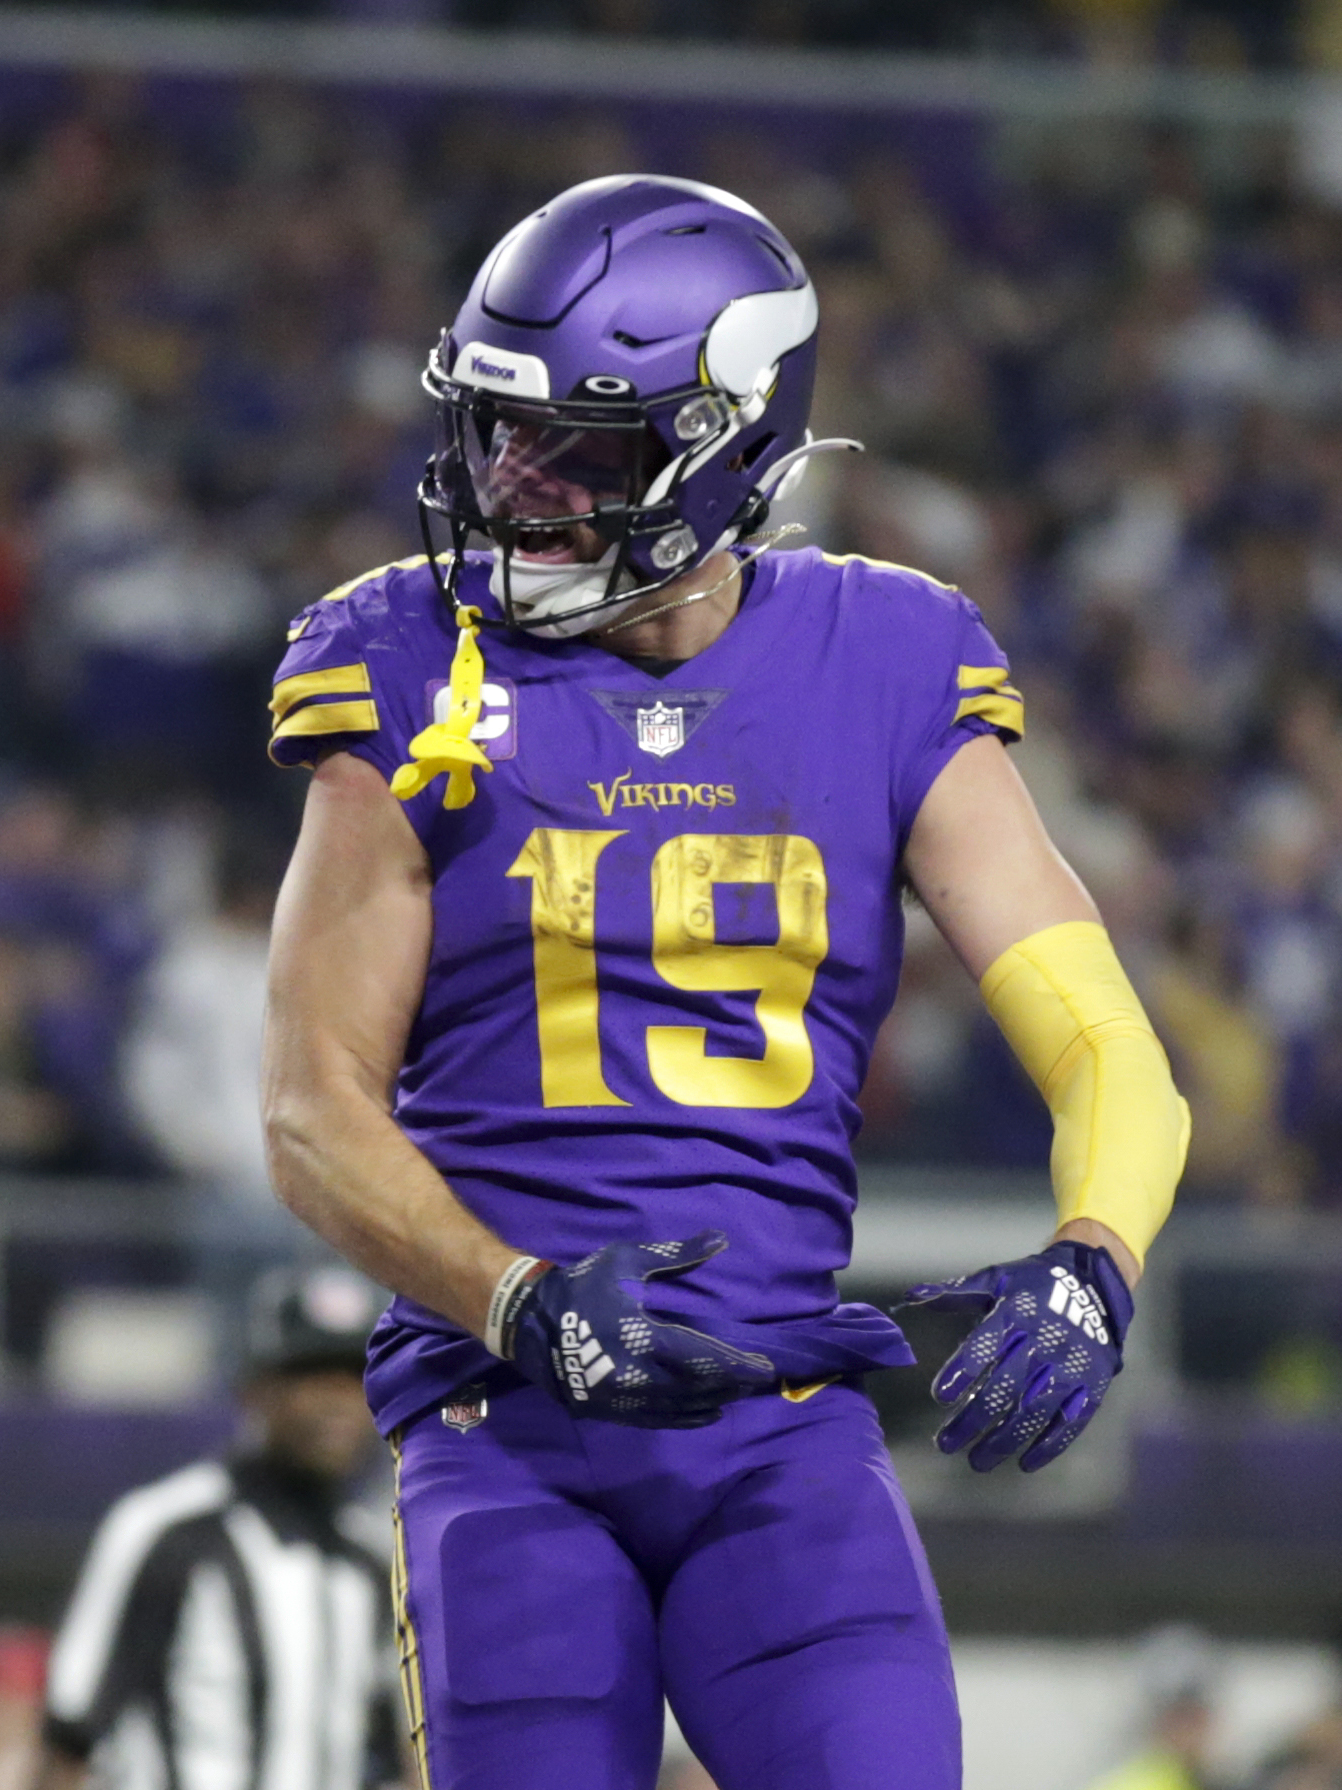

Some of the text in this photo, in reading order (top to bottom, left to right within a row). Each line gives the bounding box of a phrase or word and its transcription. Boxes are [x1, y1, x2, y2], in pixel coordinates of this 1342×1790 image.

[645, 726, 677, 745] NFL
[505, 827, 829, 1110] 19
[1049, 1265, 1110, 1346] adidas
[560, 1311, 590, 1402] adidas
